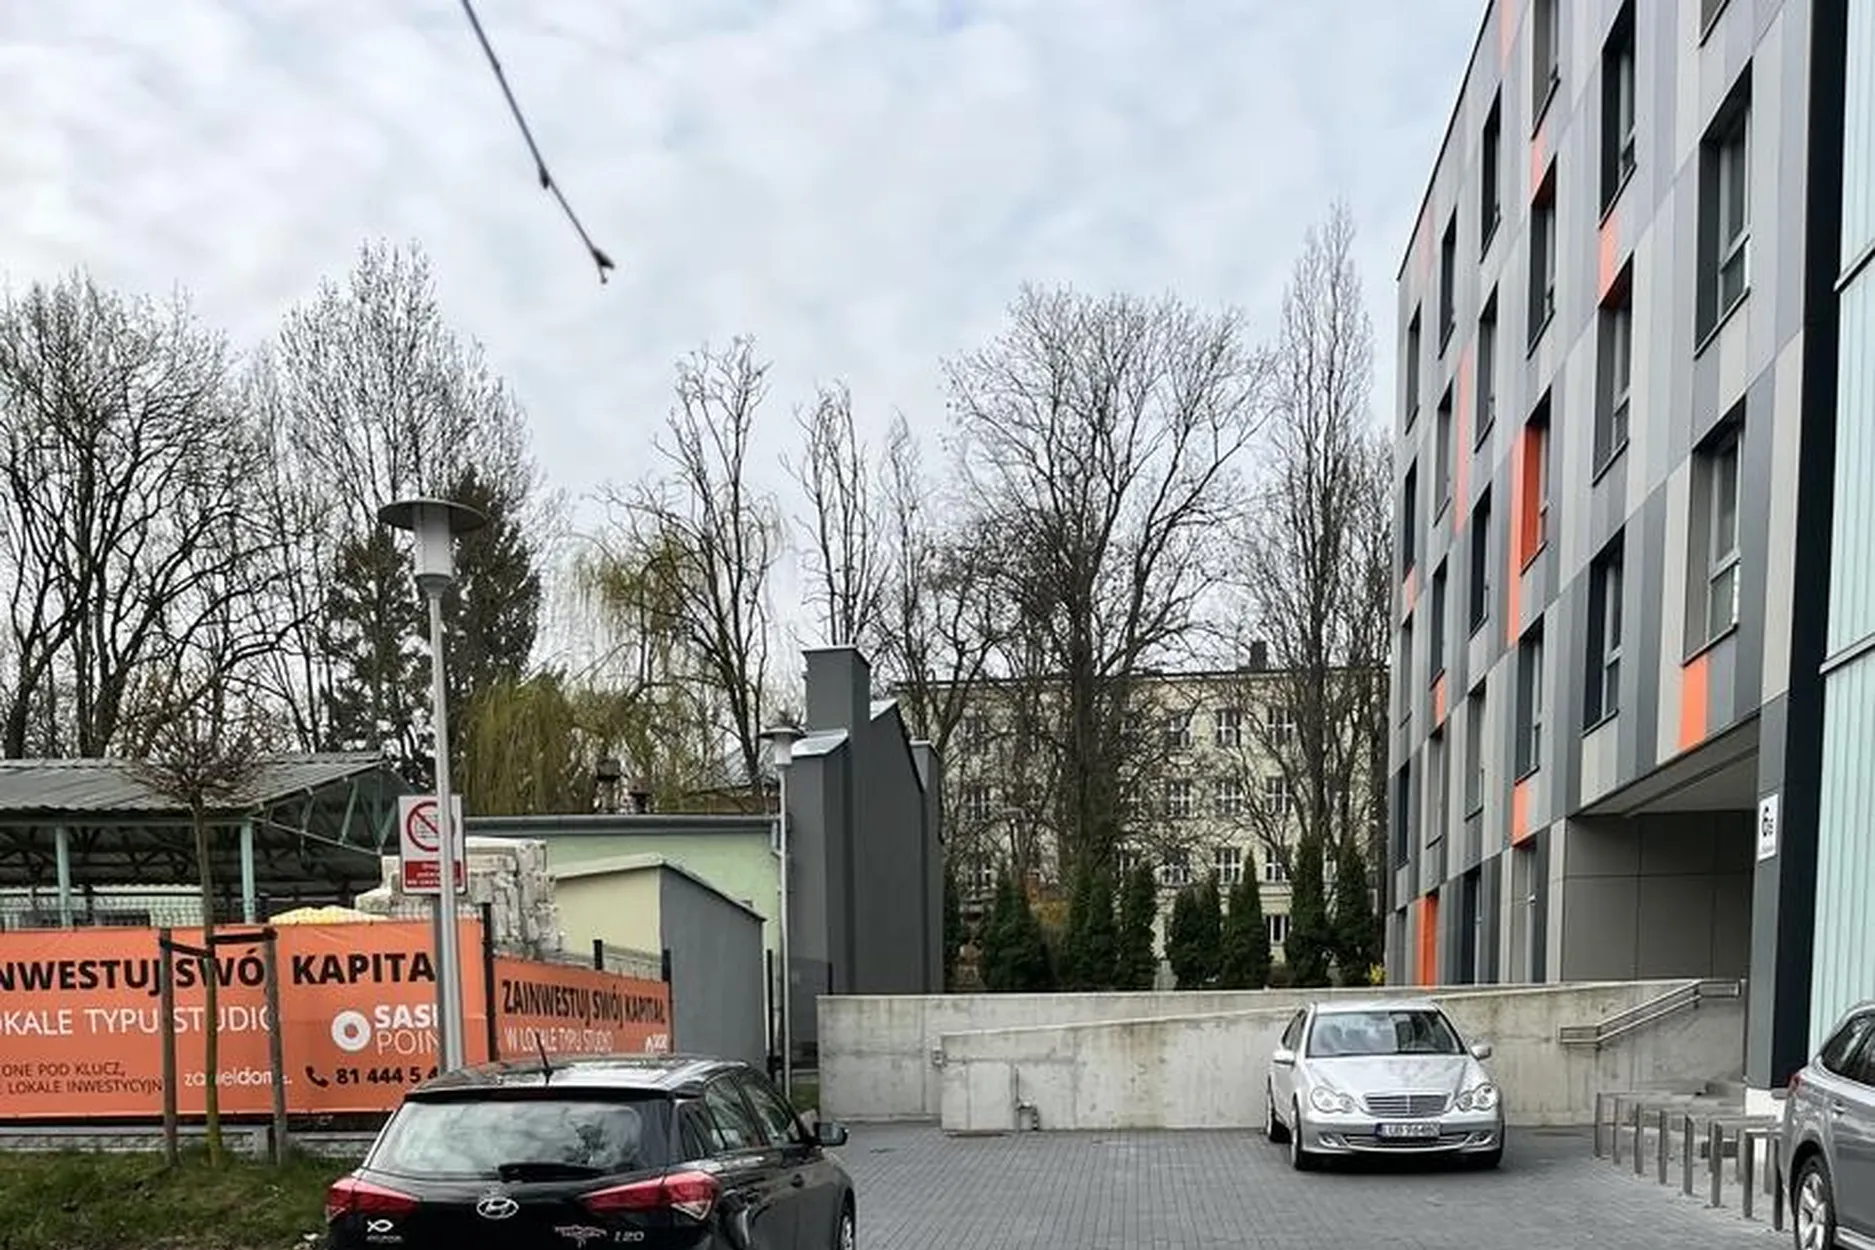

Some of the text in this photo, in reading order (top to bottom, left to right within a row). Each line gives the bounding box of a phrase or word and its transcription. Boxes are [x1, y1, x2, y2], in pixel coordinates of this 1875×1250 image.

[175, 948, 266, 994] SWÓ
[291, 952, 437, 986] KAPITA
[0, 1008, 73, 1036] KALE
[83, 1007, 160, 1034] TYPU
[374, 1003, 438, 1029] SAS
[376, 1029, 440, 1056] POIN
[8, 1078, 163, 1095] LOKALE INWESTYCYJN
[335, 1067, 360, 1085] 81
[366, 1066, 404, 1085] 444
[427, 1065, 438, 1080] 4
